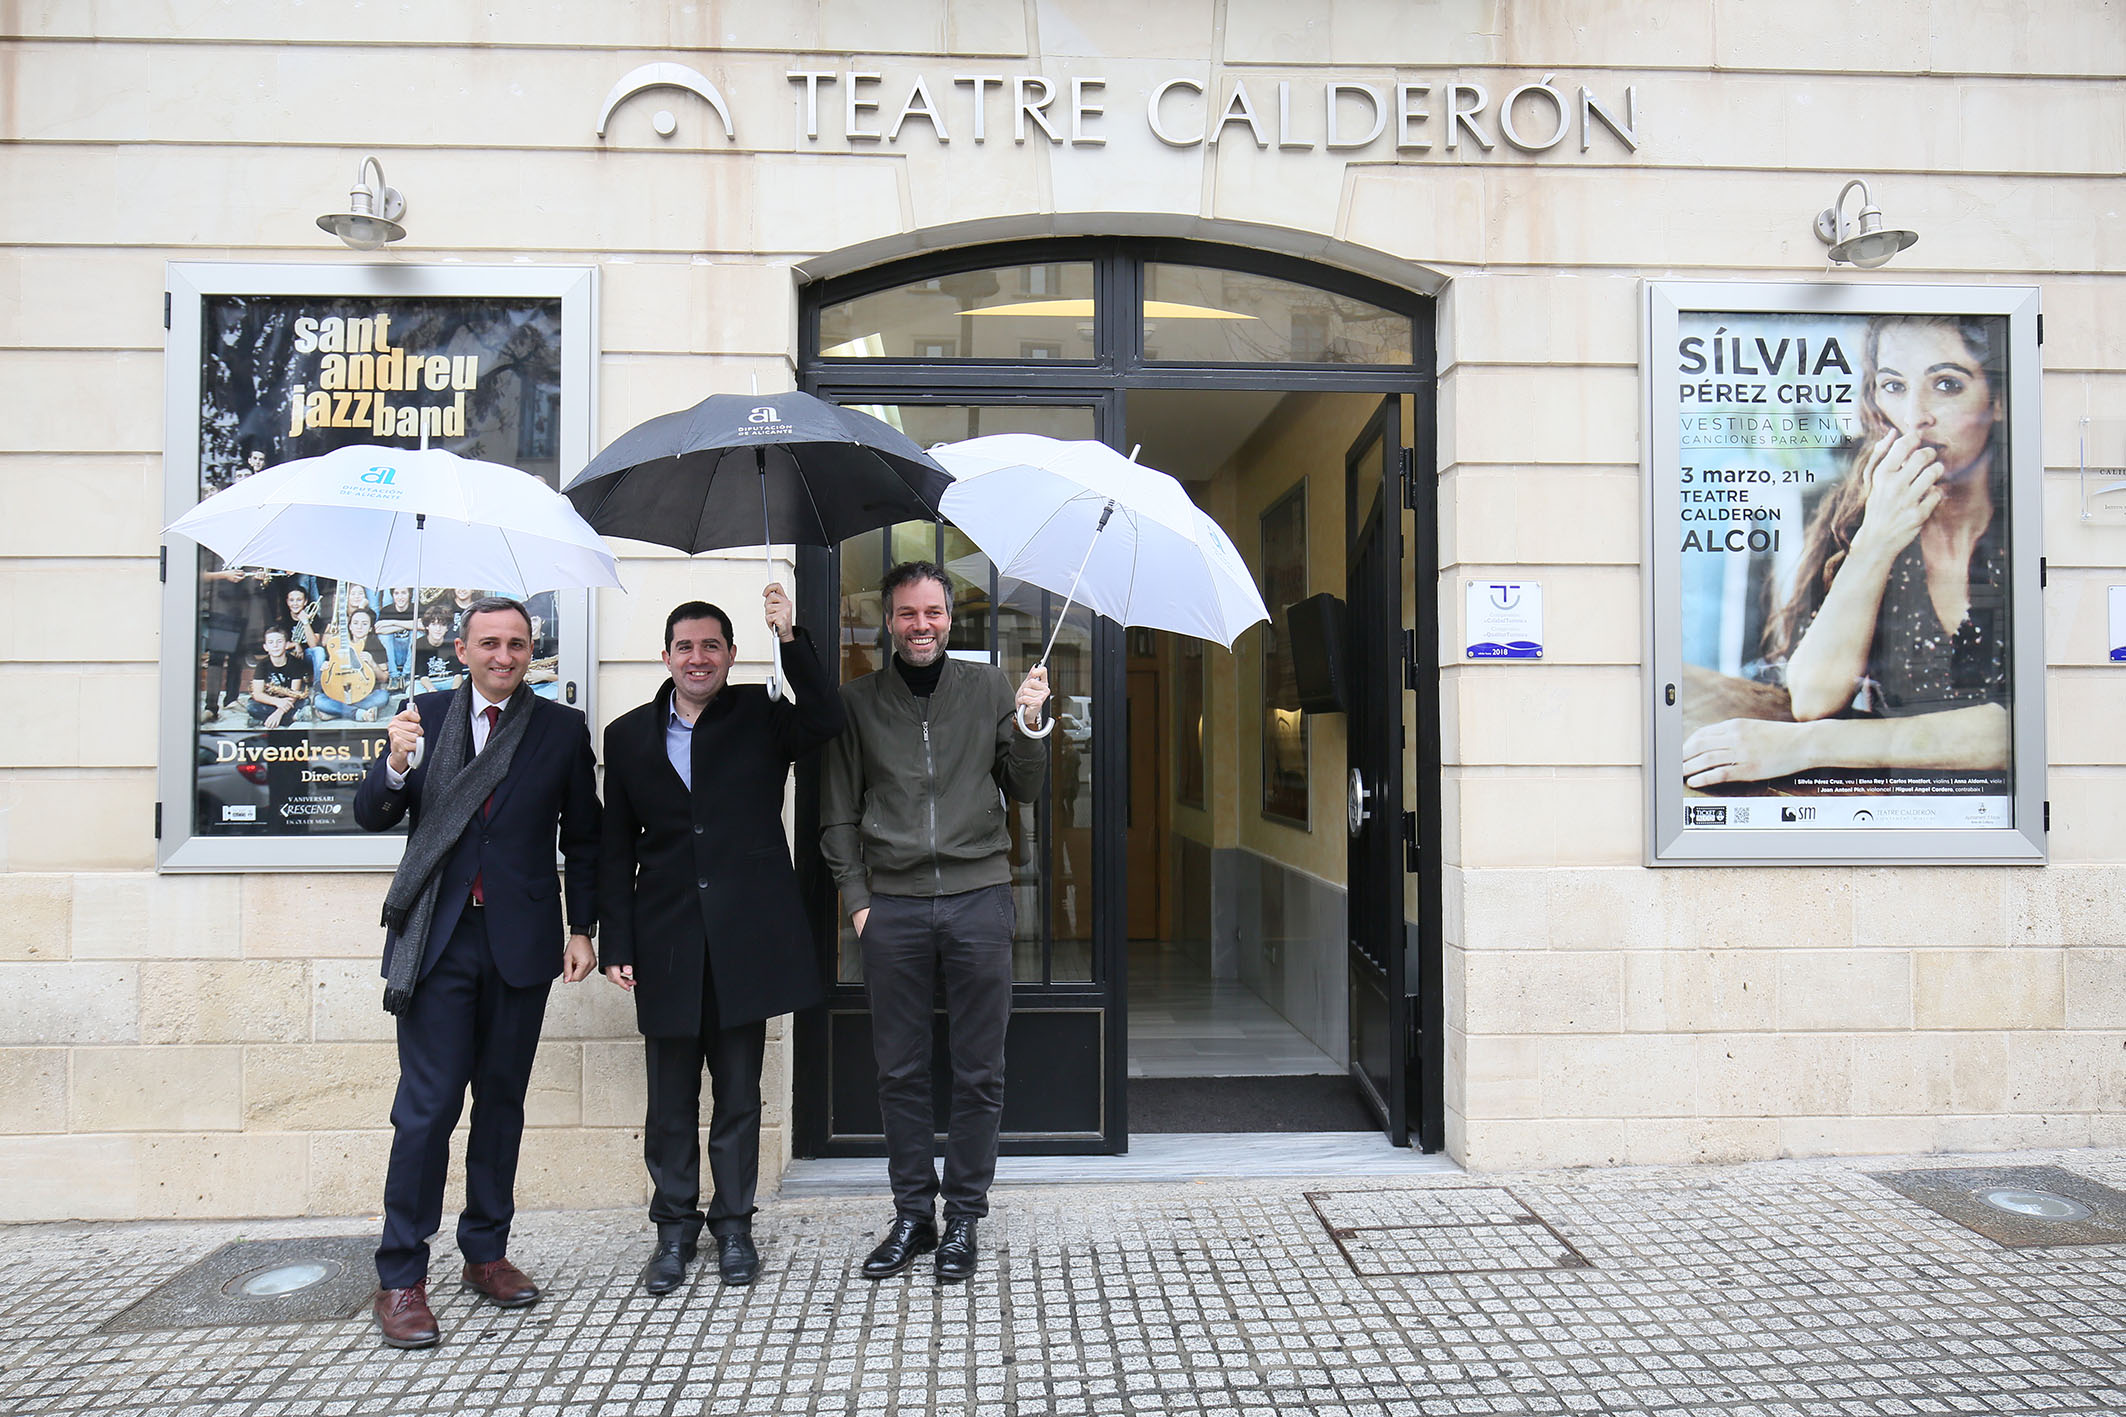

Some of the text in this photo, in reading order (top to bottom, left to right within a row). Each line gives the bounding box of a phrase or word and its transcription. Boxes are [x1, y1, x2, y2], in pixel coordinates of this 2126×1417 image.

[785, 69, 1639, 152] TEATRE CALDERÓN
[294, 313, 391, 353] sant
[1678, 326, 1853, 376] SÍLVIA
[320, 347, 479, 392] andreu
[1679, 379, 1852, 404] PÉREZ CRUZ
[1681, 417, 1853, 432] VESTIDA DE NIT
[1681, 434, 1853, 445] CANCIONES PARA VIVIR
[1681, 467, 1815, 486] 3 marzo, 21 h
[1680, 489, 1749, 503] TEATRE
[1680, 505, 1781, 521] CALDERÓN
[1680, 529, 1780, 553] ALCOI
[1492, 648, 1508, 656] 2018
[216, 739, 351, 763] Divendres
[301, 769, 359, 782] Director:
[1798, 807, 1816, 820] sm
